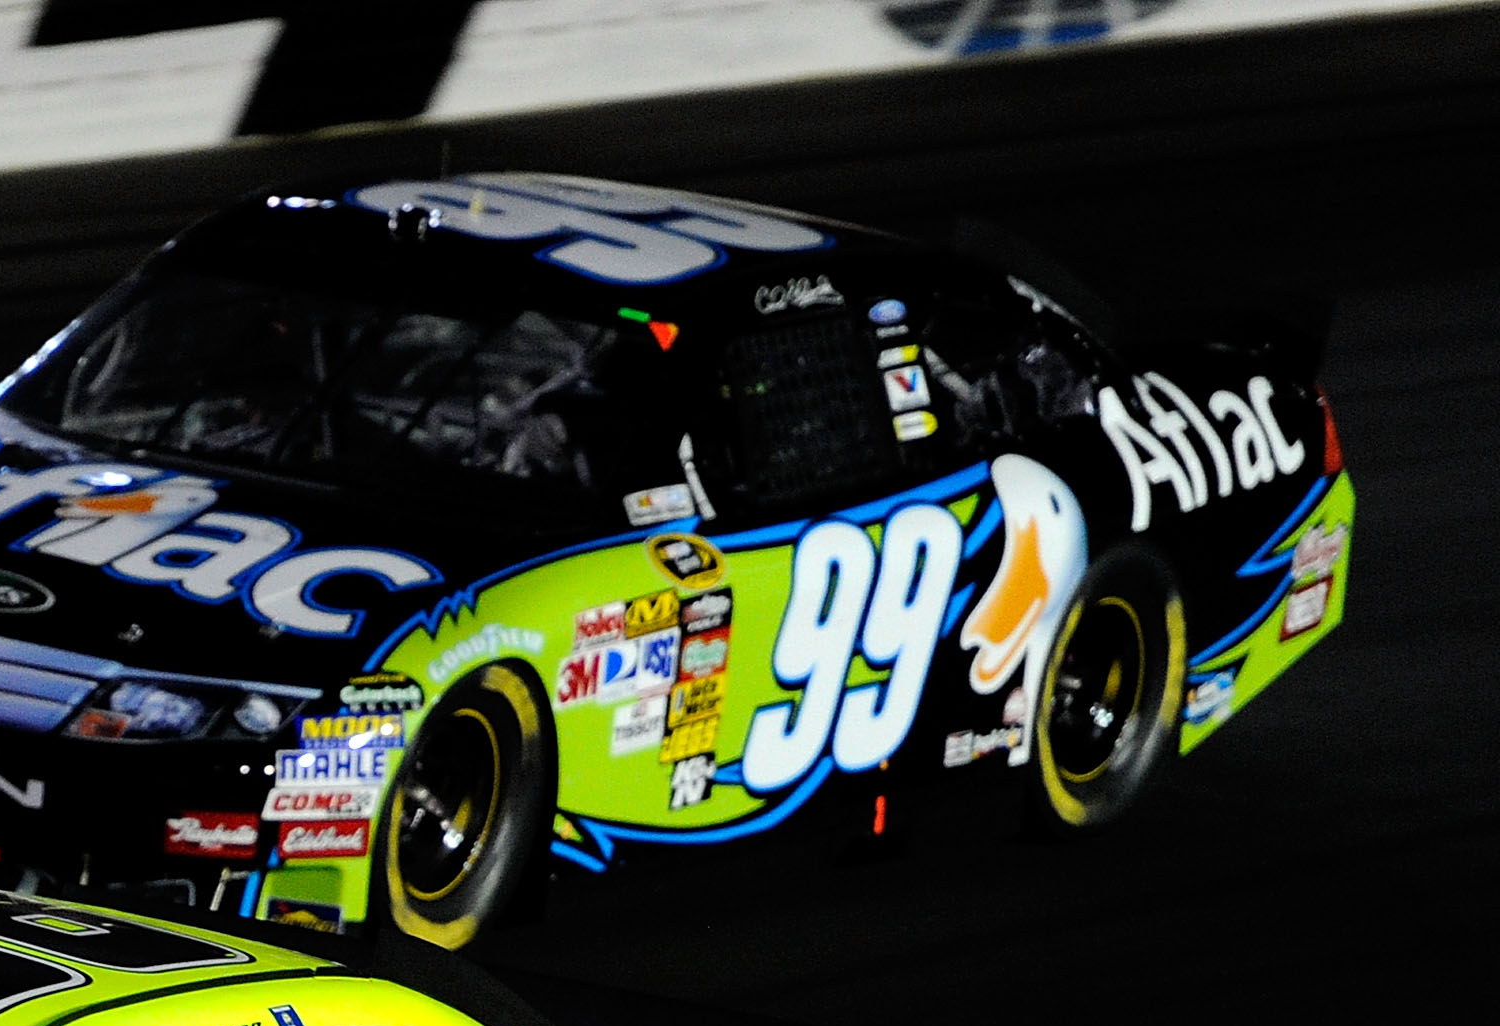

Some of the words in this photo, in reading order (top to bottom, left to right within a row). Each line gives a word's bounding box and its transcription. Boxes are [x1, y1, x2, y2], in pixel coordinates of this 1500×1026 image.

[1098, 371, 1306, 532] Aflac
[740, 502, 965, 796] 99
[557, 651, 601, 703] 3M
[278, 750, 387, 781] MAHLE
[273, 791, 352, 813] COMP
